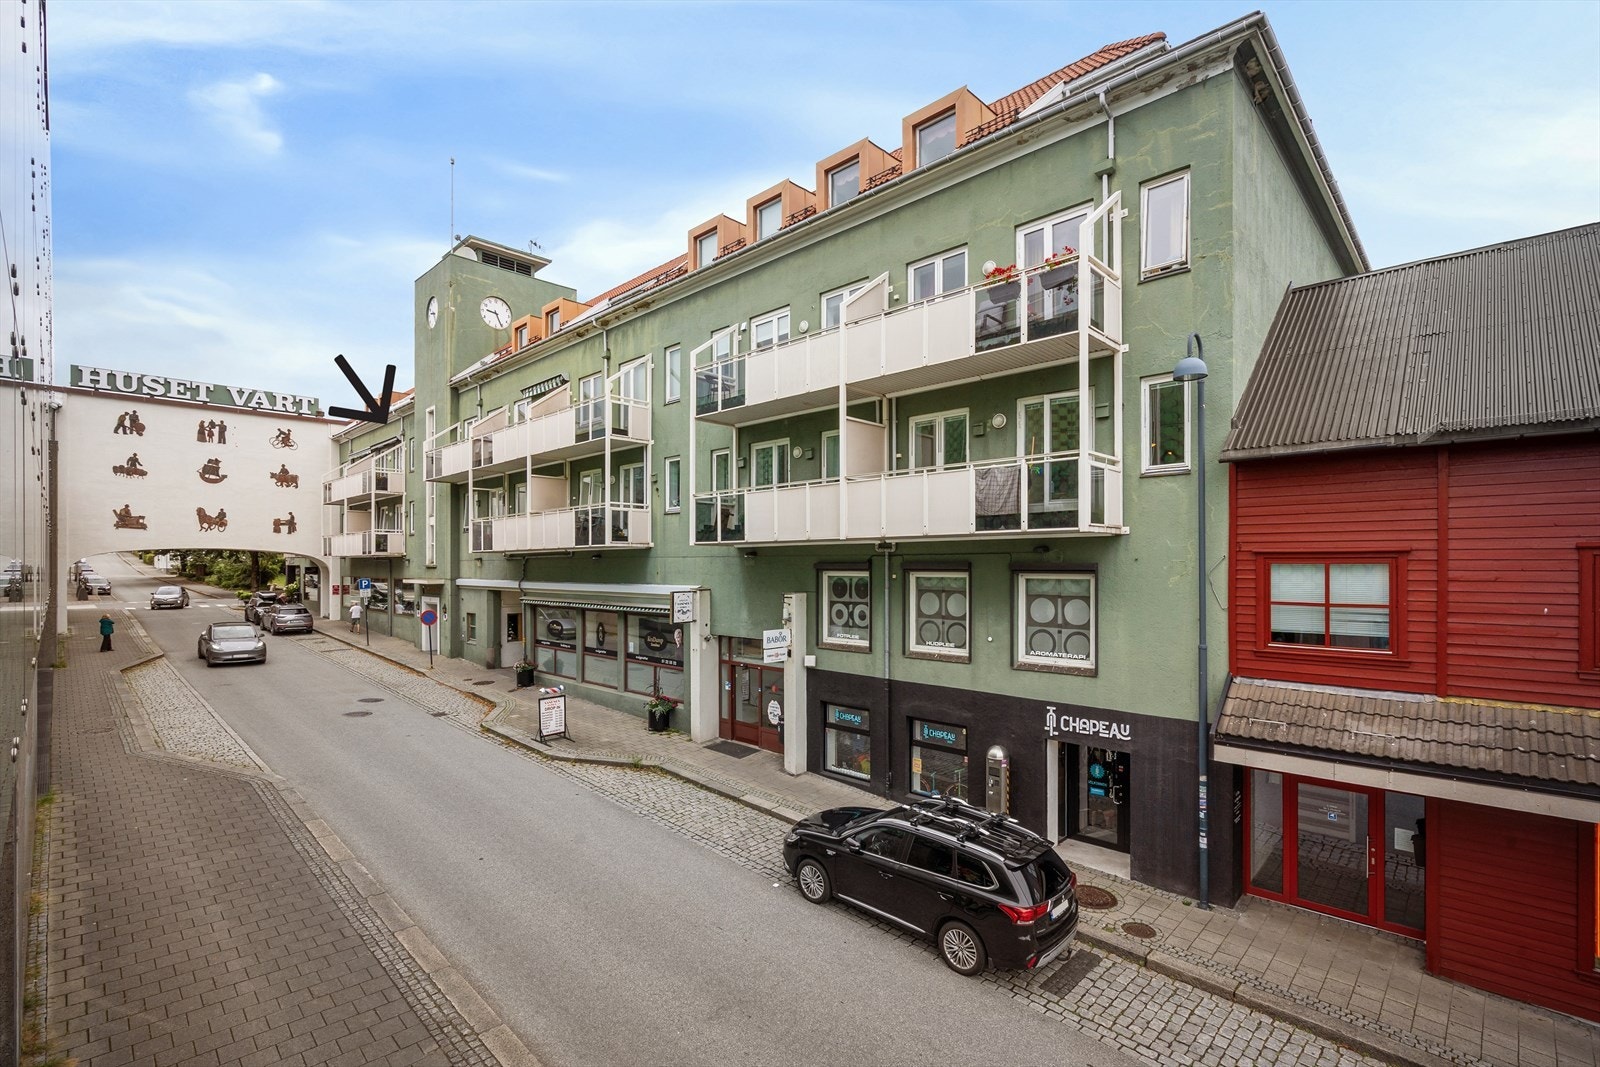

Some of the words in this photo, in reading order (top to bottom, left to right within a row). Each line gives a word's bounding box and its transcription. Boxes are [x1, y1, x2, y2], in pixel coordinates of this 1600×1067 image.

[78, 365, 214, 402] HUSET
[362, 580, 368, 589] P
[1029, 650, 1087, 660] AROMATERAPI
[839, 712, 861, 724] CHAPEAU
[1060, 715, 1131, 740] CHAPEAU
[928, 730, 955, 741] CHAPEAU
